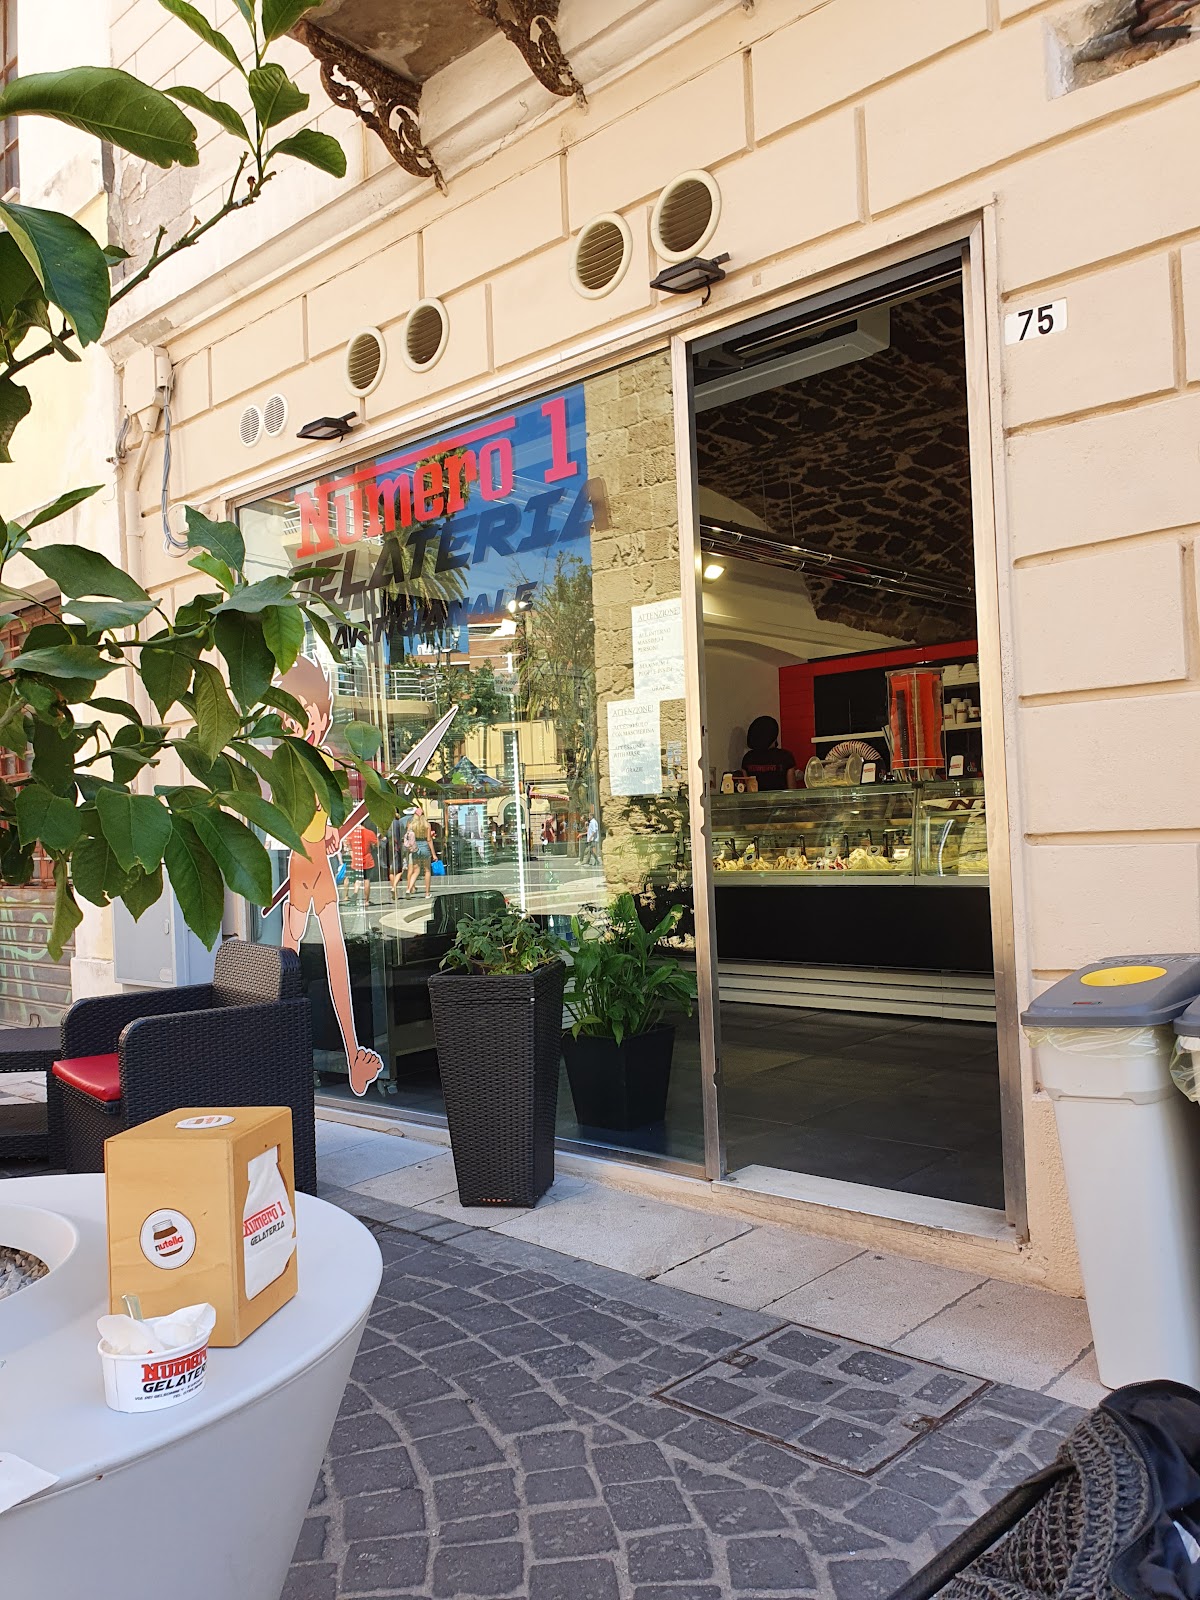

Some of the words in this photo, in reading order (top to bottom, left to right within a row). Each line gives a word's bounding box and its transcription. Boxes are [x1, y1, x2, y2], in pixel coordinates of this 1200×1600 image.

[1017, 303, 1054, 342] 75
[294, 416, 515, 559] Numero
[541, 396, 578, 484] 1
[243, 1203, 279, 1238] Numero
[276, 1201, 286, 1216] 1
[250, 1220, 285, 1246] GELATERIA
[155, 1234, 184, 1252] nutella
